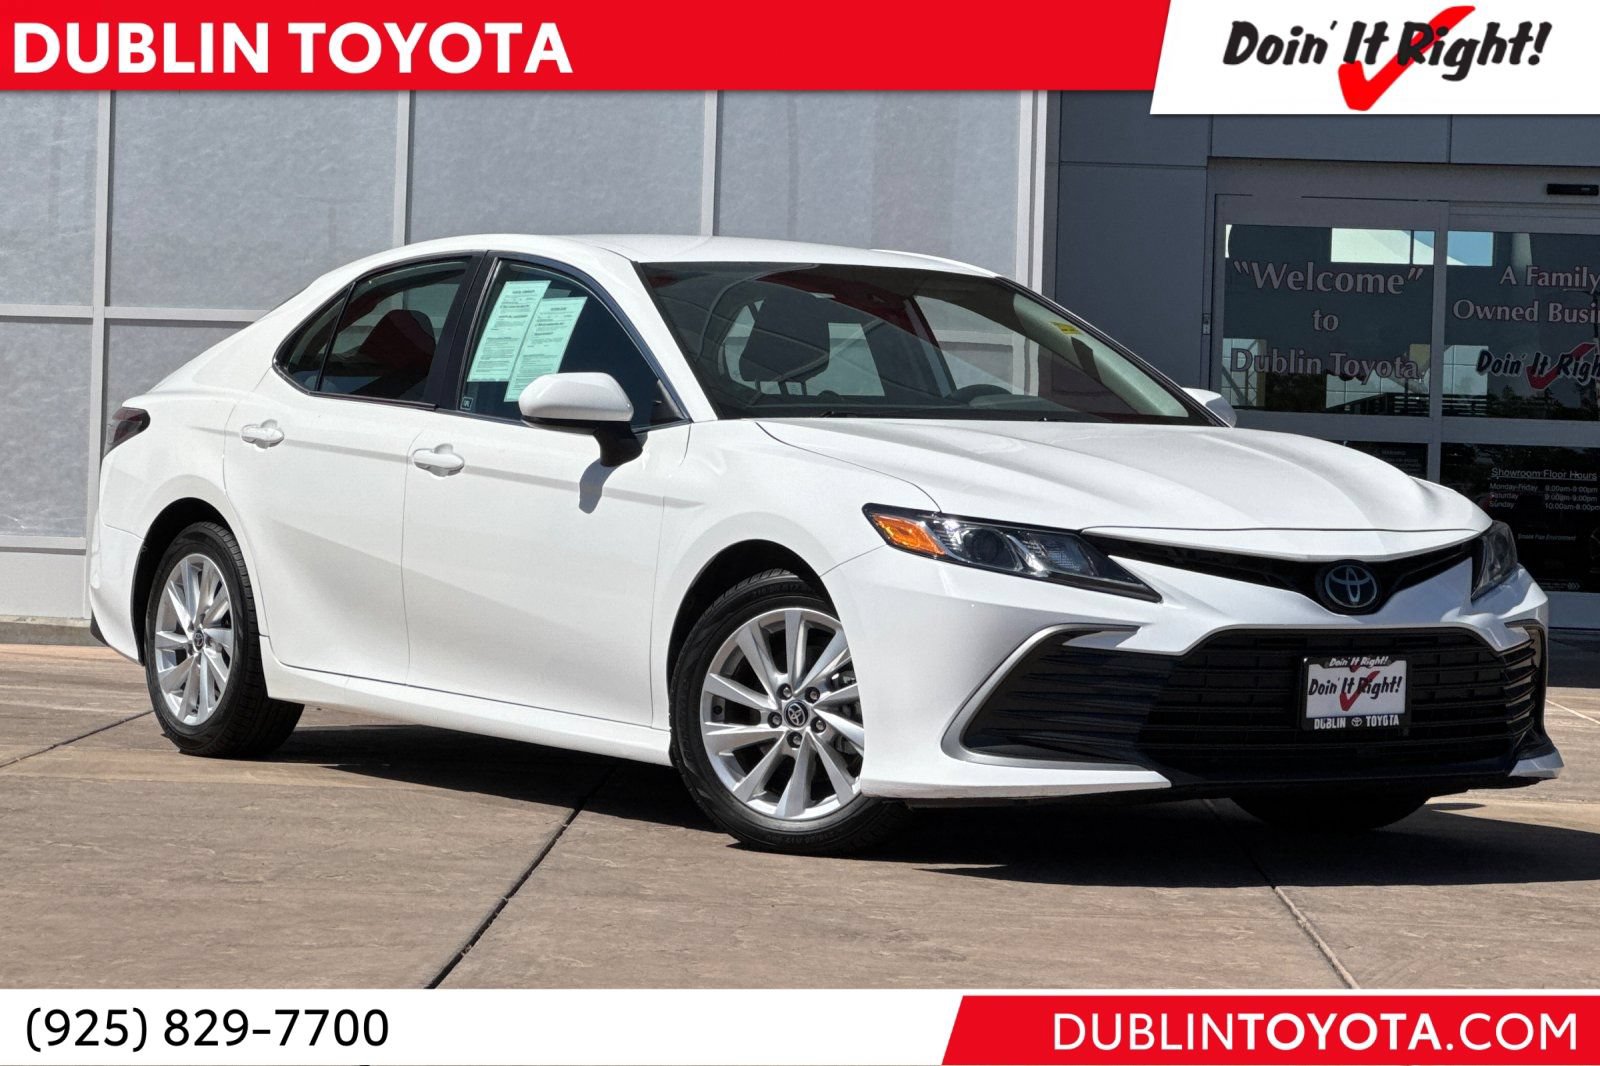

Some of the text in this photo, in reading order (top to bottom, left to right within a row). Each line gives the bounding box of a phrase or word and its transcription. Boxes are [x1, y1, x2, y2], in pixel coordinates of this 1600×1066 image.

[1499, 265, 1600, 295] A Family
[1312, 309, 1340, 332] to
[1453, 299, 1600, 324] Owned Busi
[1230, 347, 1420, 386] Dublin Toyota
[1476, 349, 1527, 375] Doin'
[1532, 351, 1549, 376] It
[1490, 467, 1598, 480] Showroom Floor Hours
[1489, 492, 1519, 501] Saturday
[1489, 500, 1515, 510] Sunday
[1360, 656, 1389, 669] Right!
[1308, 675, 1403, 700] Doin' It Right!
[1314, 714, 1399, 730] DUBLIN TOYOTA
